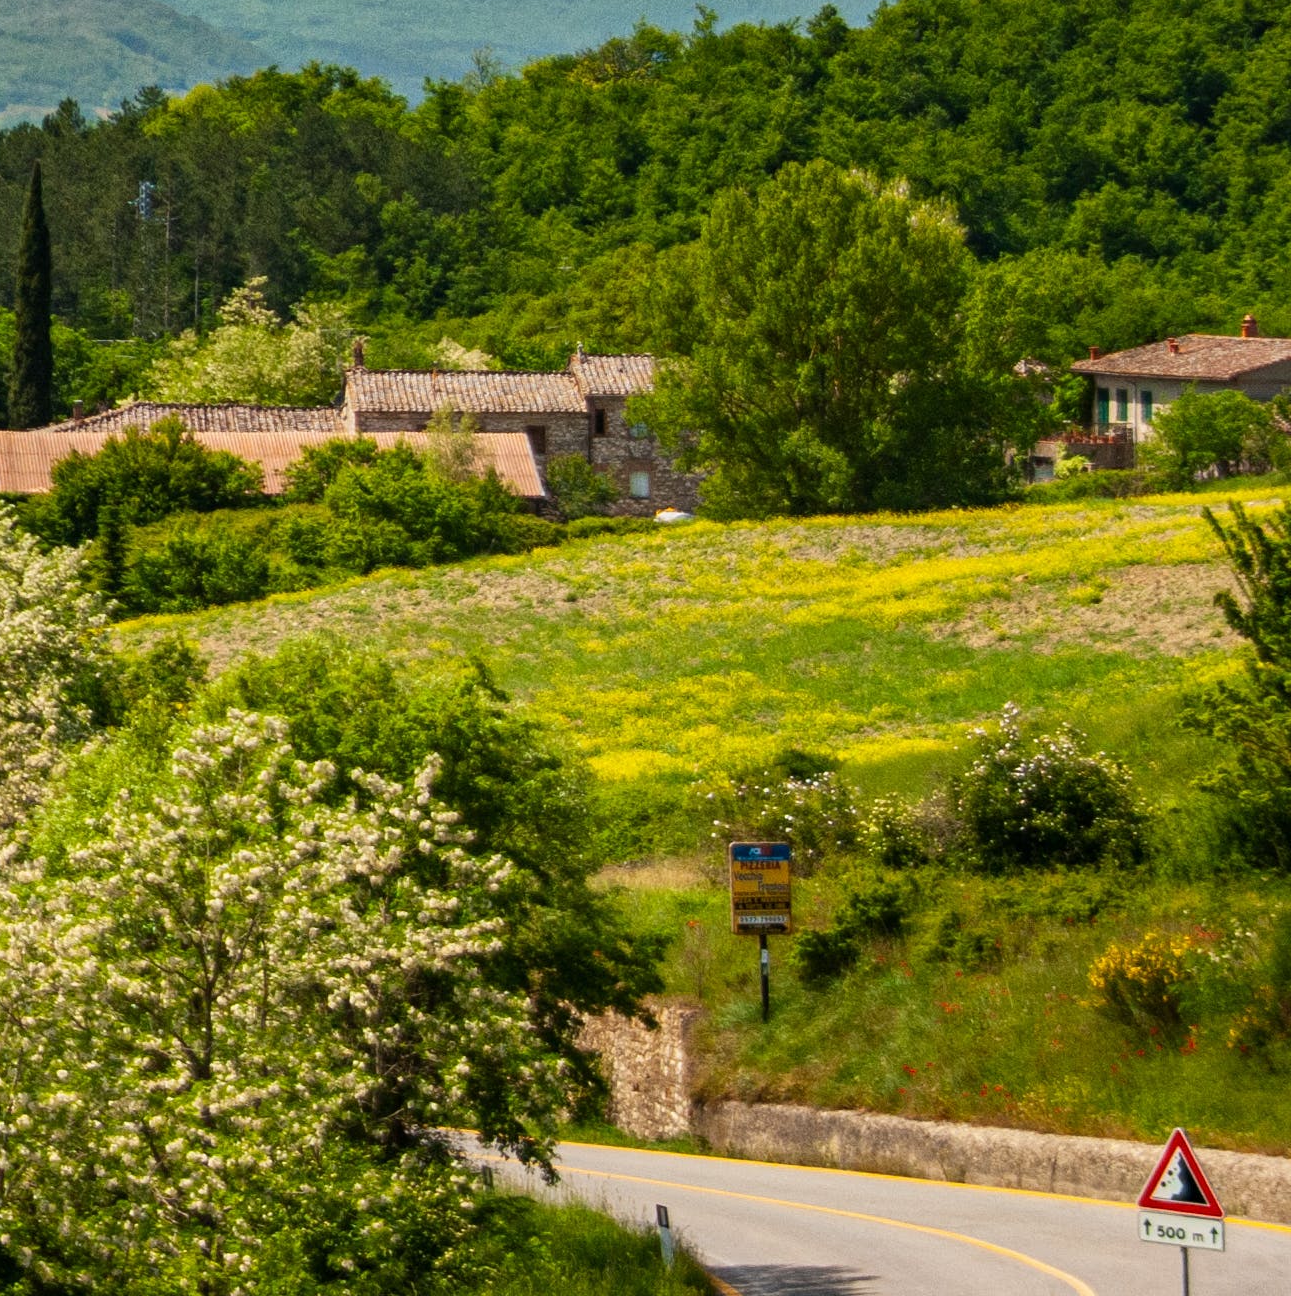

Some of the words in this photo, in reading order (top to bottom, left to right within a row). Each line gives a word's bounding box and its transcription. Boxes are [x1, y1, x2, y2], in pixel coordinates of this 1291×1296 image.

[740, 860, 781, 869] PIZZERIA
[1157, 1225, 1186, 1240] 500
[1192, 1232, 1204, 1242] m
